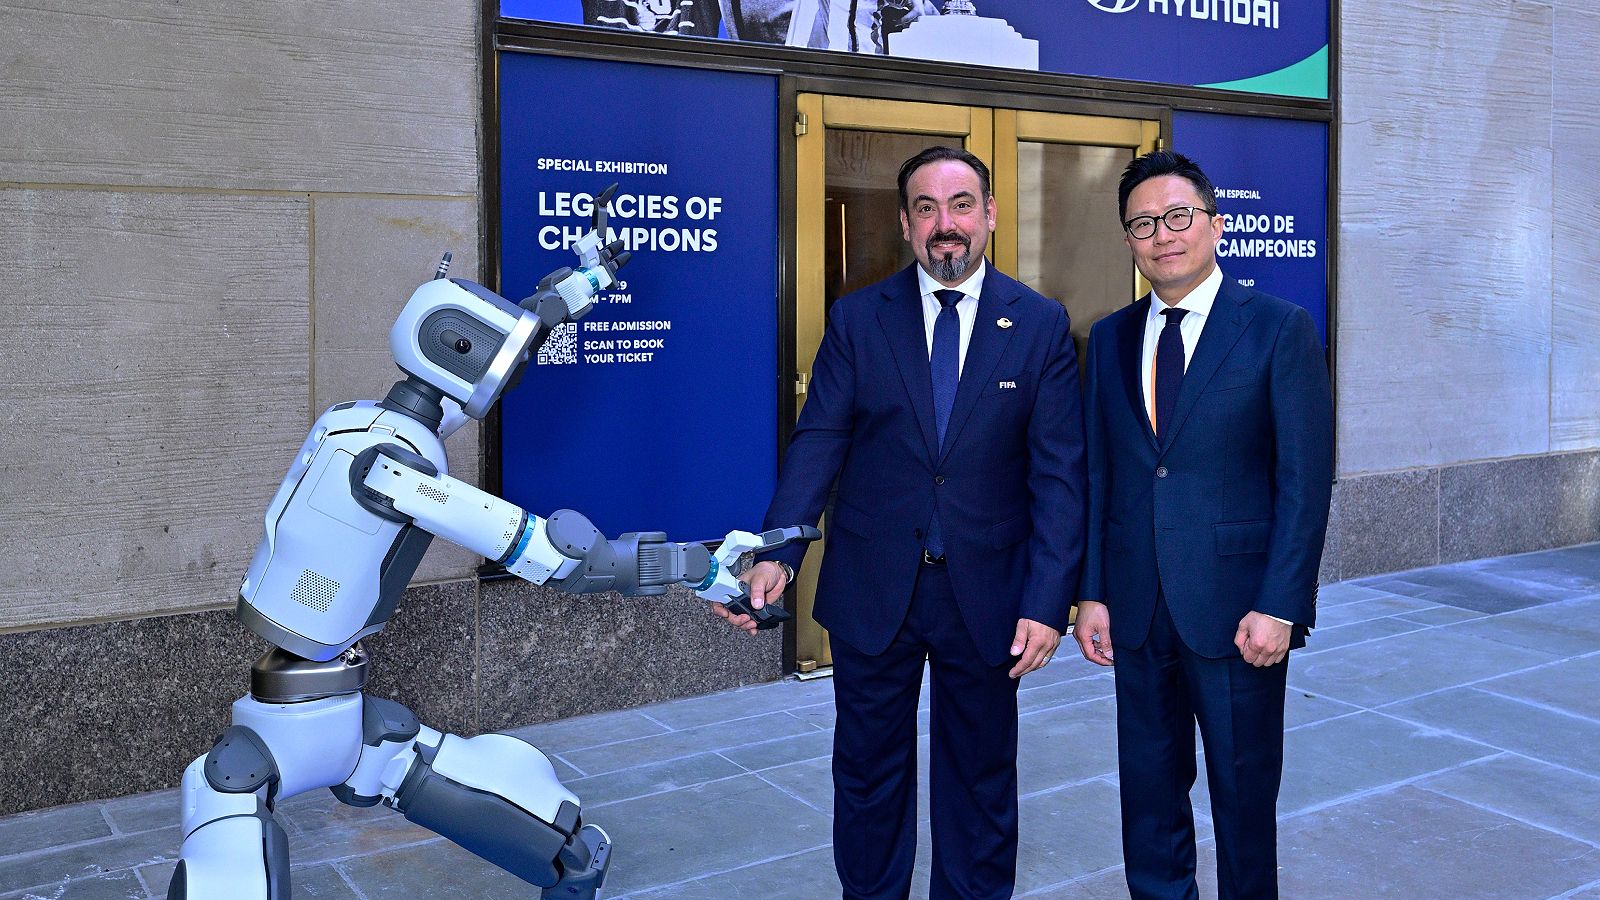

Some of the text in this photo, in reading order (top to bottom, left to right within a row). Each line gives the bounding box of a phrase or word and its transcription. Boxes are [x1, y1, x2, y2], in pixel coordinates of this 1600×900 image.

[537, 158, 668, 175] SPECIAL EXHIBITION
[1227, 189, 1261, 200] ESPECIAL
[685, 197, 722, 220] OF
[1223, 214, 1294, 233] GADO DE
[538, 225, 718, 252] CHMPIONS
[1215, 238, 1317, 258] CAMPEONES
[608, 294, 632, 304] 7PM
[584, 321, 671, 332] FREE ADMISSION
[584, 339, 665, 351] SCAN TO BOOK
[584, 353, 654, 364] YOUR TICKET
[999, 381, 1017, 389] FIFA
